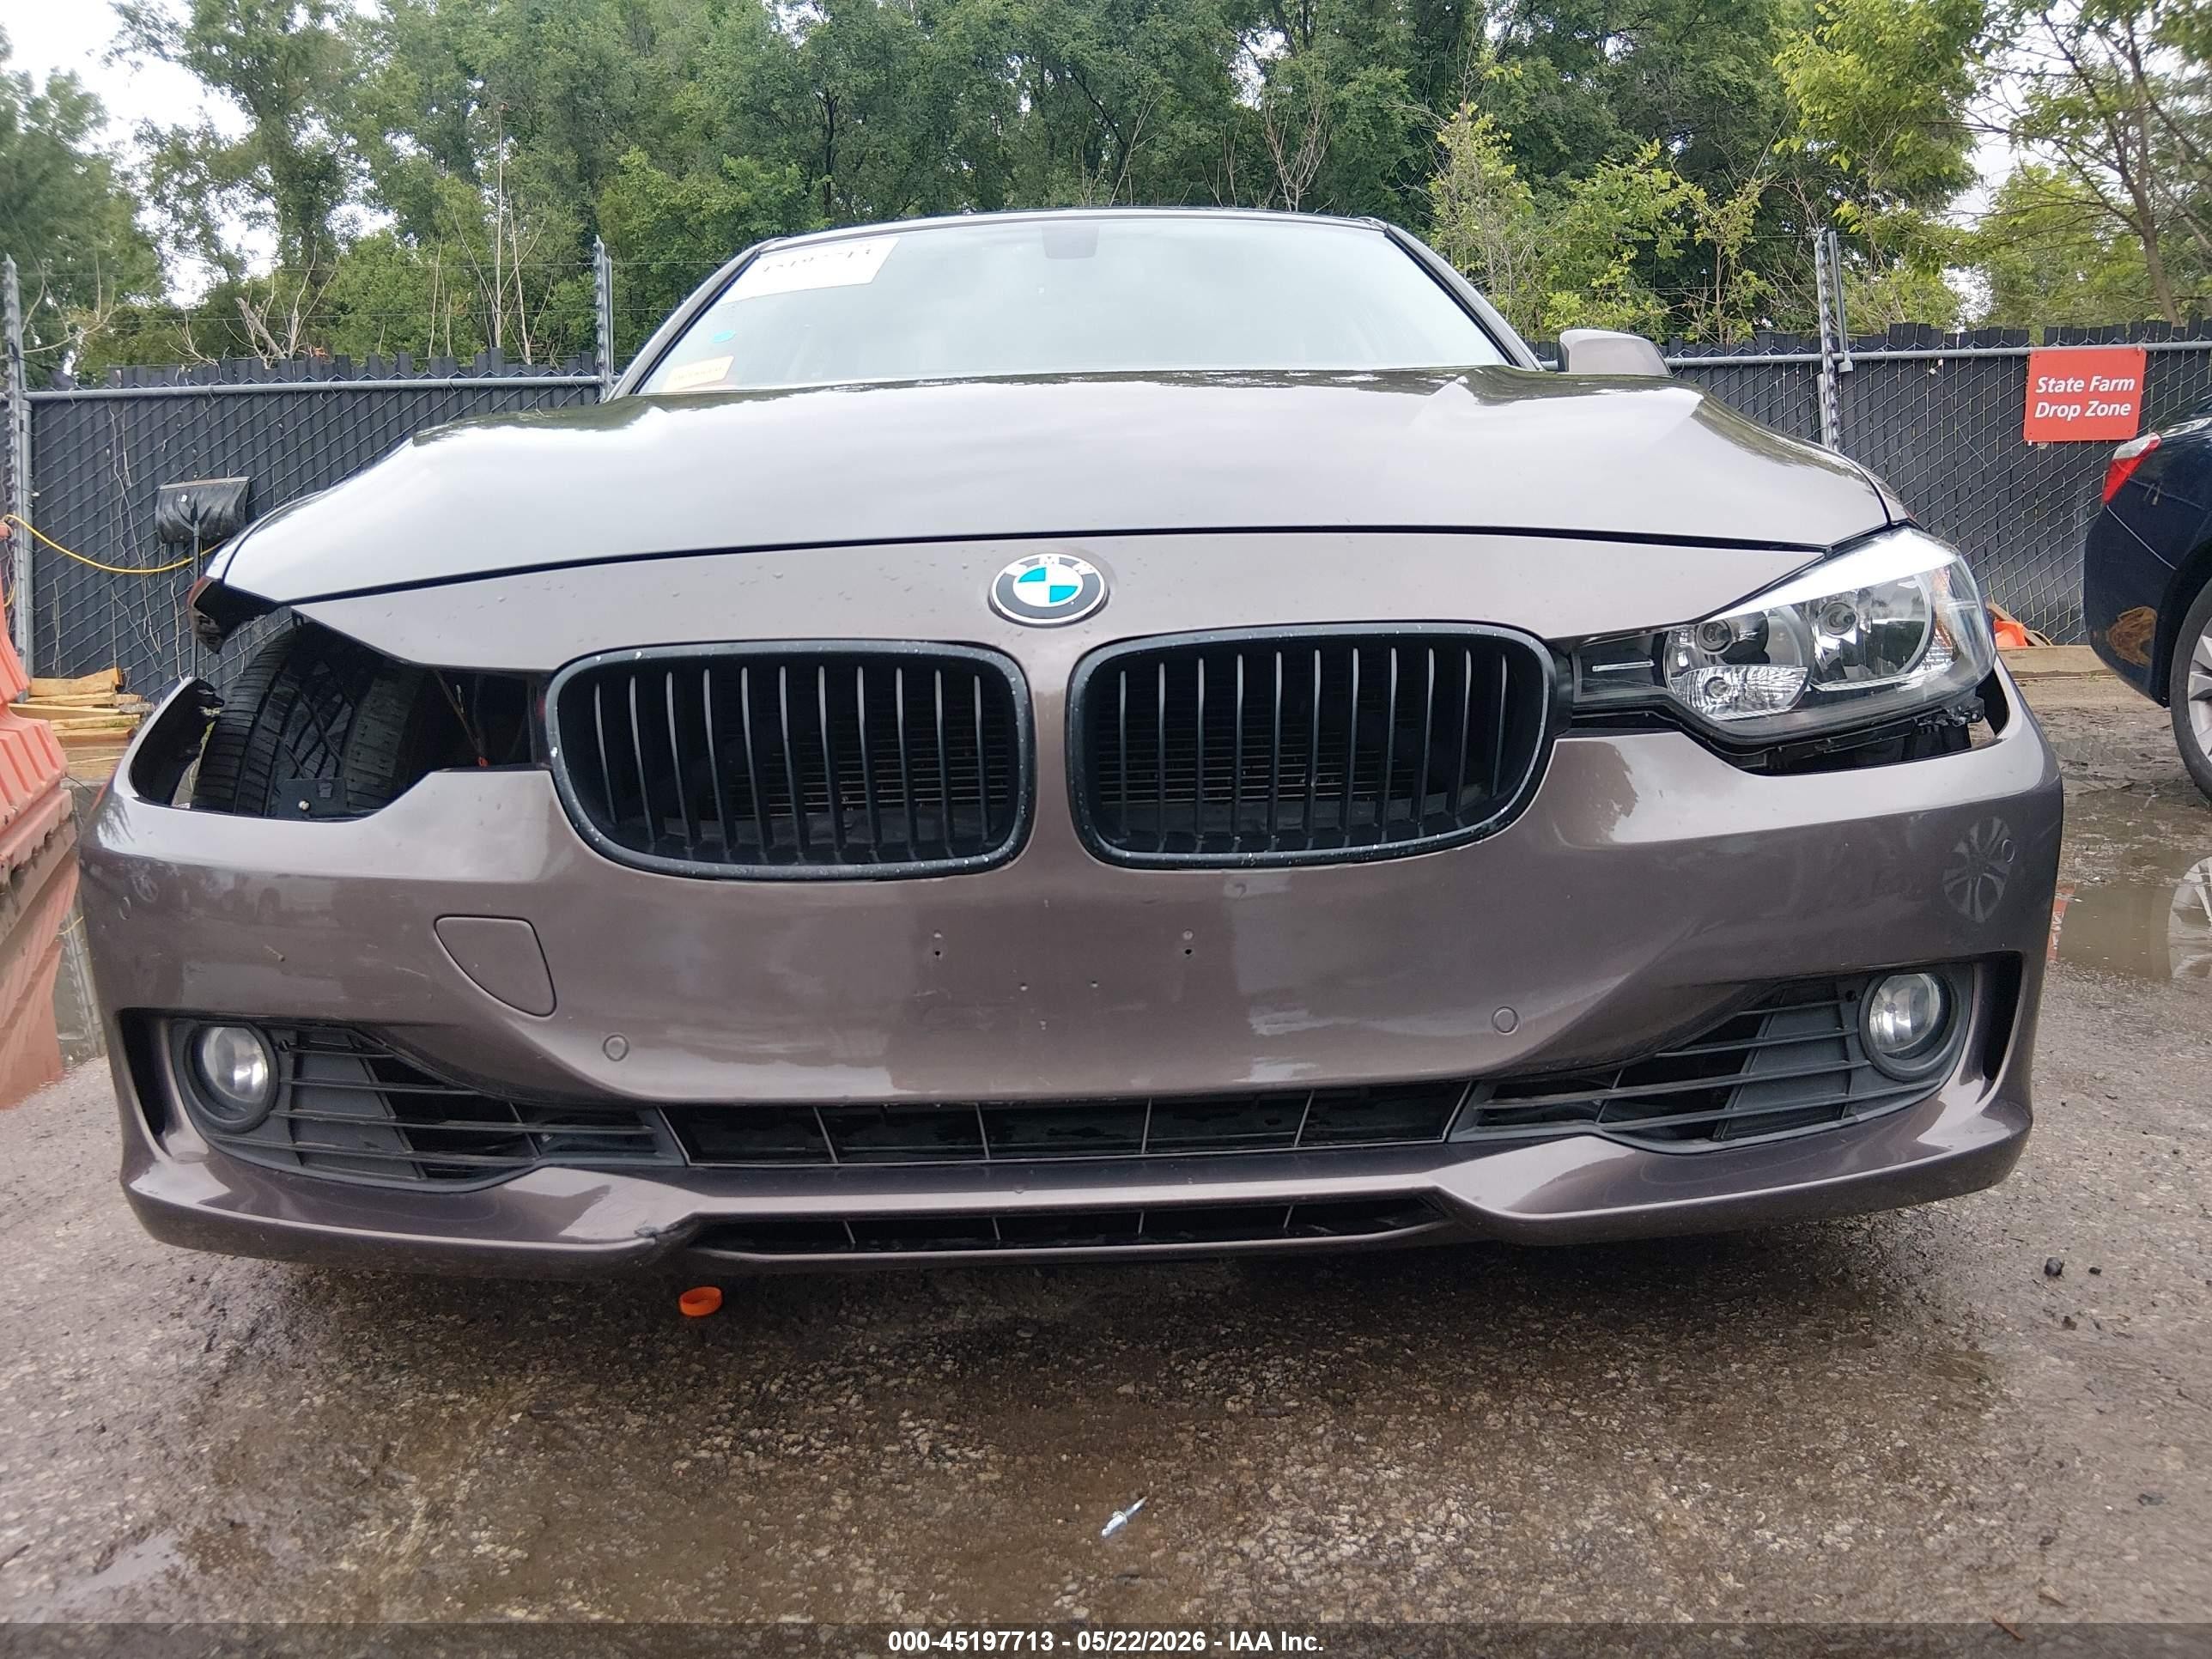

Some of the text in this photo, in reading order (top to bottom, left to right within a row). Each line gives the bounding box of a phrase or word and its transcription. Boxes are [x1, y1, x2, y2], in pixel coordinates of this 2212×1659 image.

[2035, 375, 2135, 393] State Farm
[2034, 401, 2131, 421] Drop Zone
